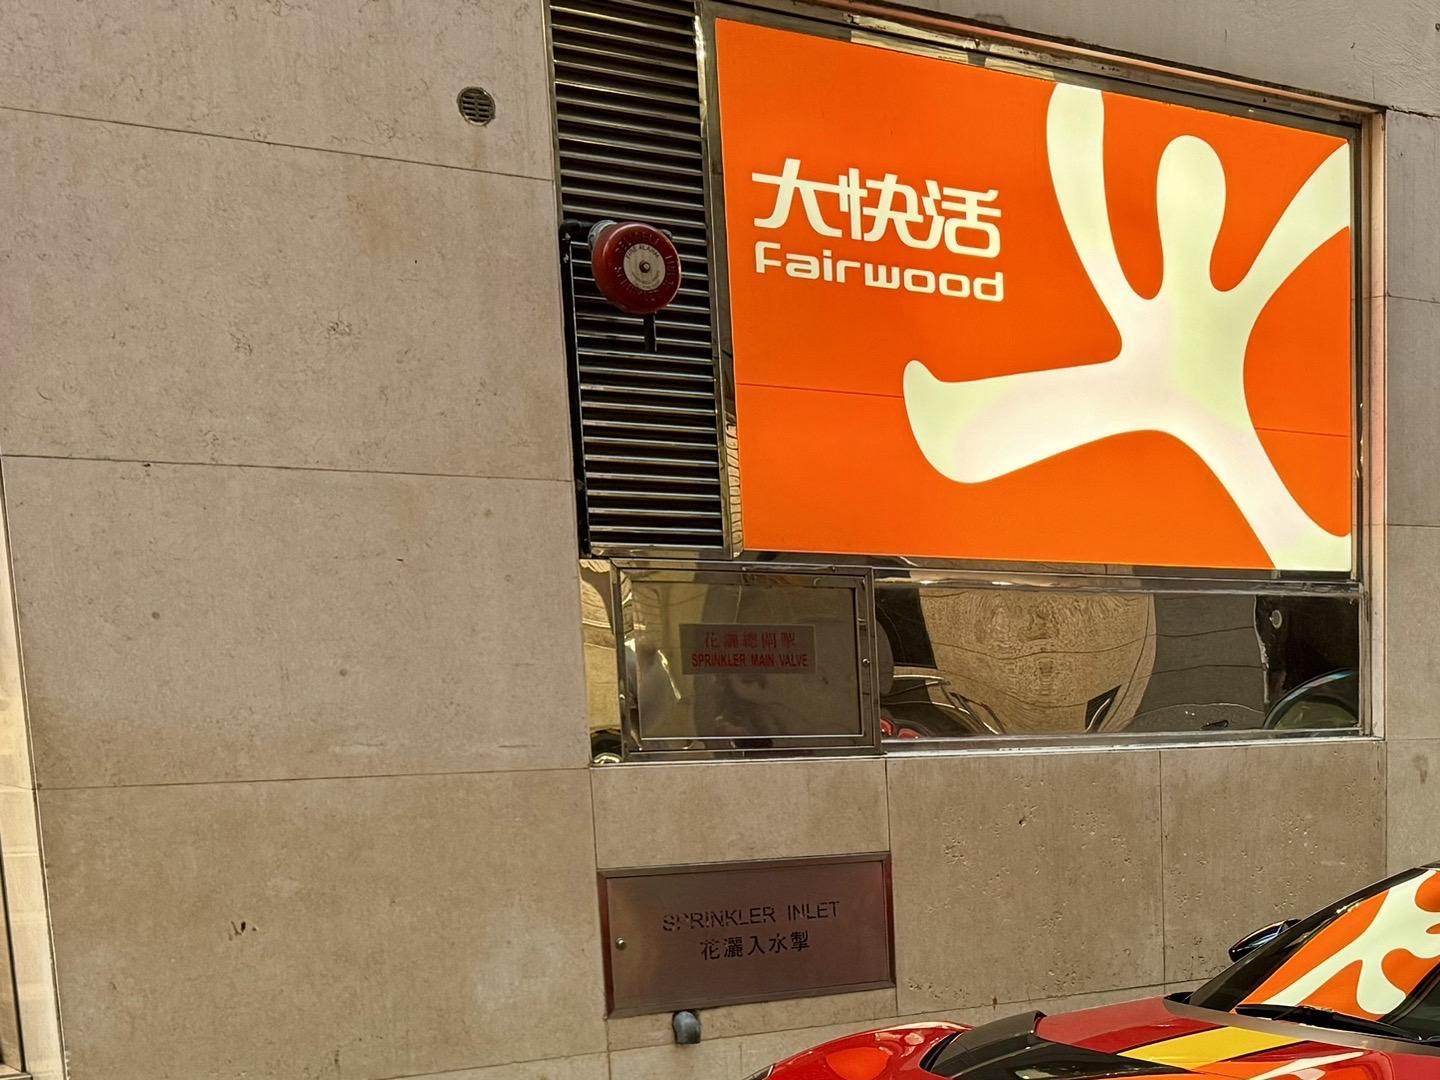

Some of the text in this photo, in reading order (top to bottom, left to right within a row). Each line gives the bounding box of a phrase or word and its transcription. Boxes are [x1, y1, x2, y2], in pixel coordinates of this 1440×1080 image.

[751, 157, 1002, 259] 大快活
[754, 241, 1004, 302] Fairwood
[691, 653, 809, 668] SPRINKLER MAIN VALVE
[662, 901, 841, 931] SPRINKLER INLET
